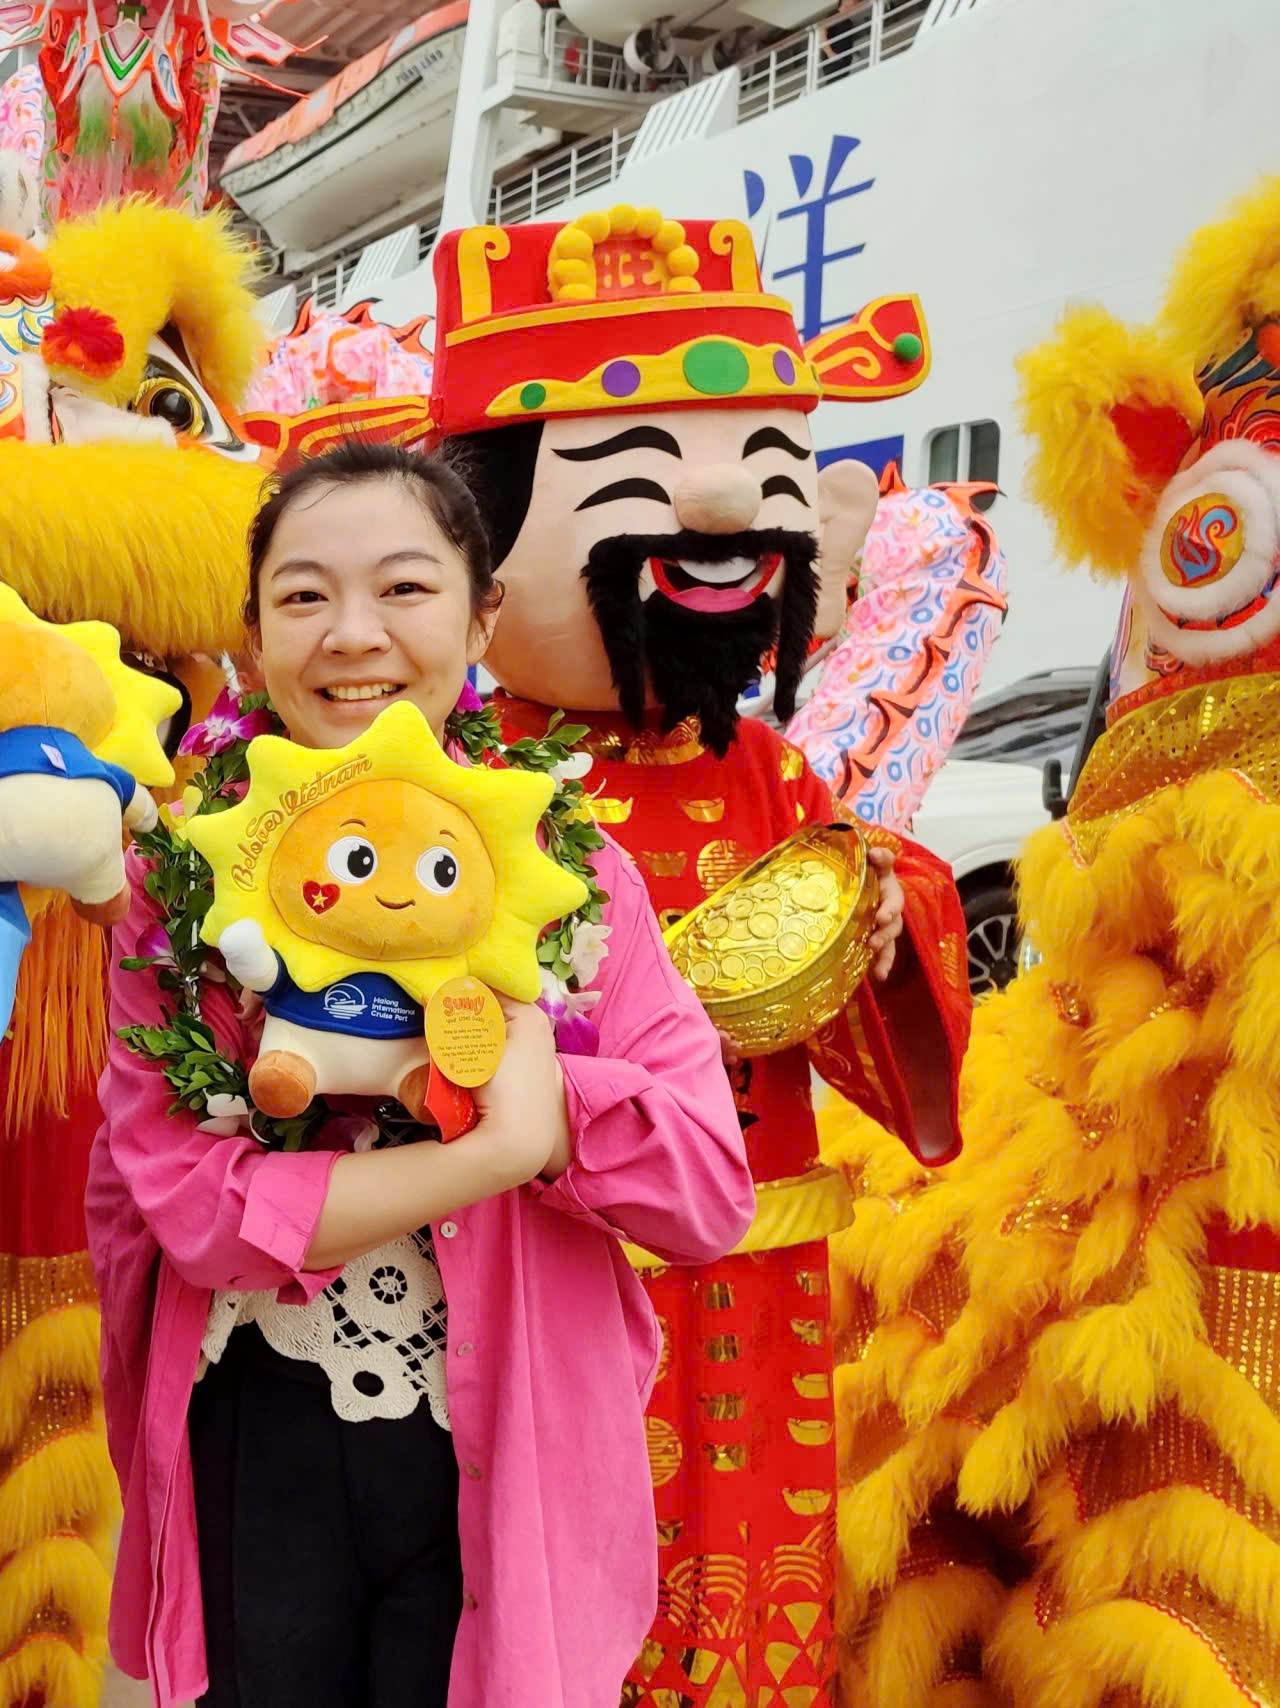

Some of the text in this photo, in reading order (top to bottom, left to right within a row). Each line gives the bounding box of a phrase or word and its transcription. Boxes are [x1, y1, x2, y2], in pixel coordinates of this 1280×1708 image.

[231, 753, 373, 893] Beloved Vietnam
[373, 996, 400, 1007] Halong
[371, 1003, 416, 1016] International
[370, 1010, 409, 1022] Cruise Port
